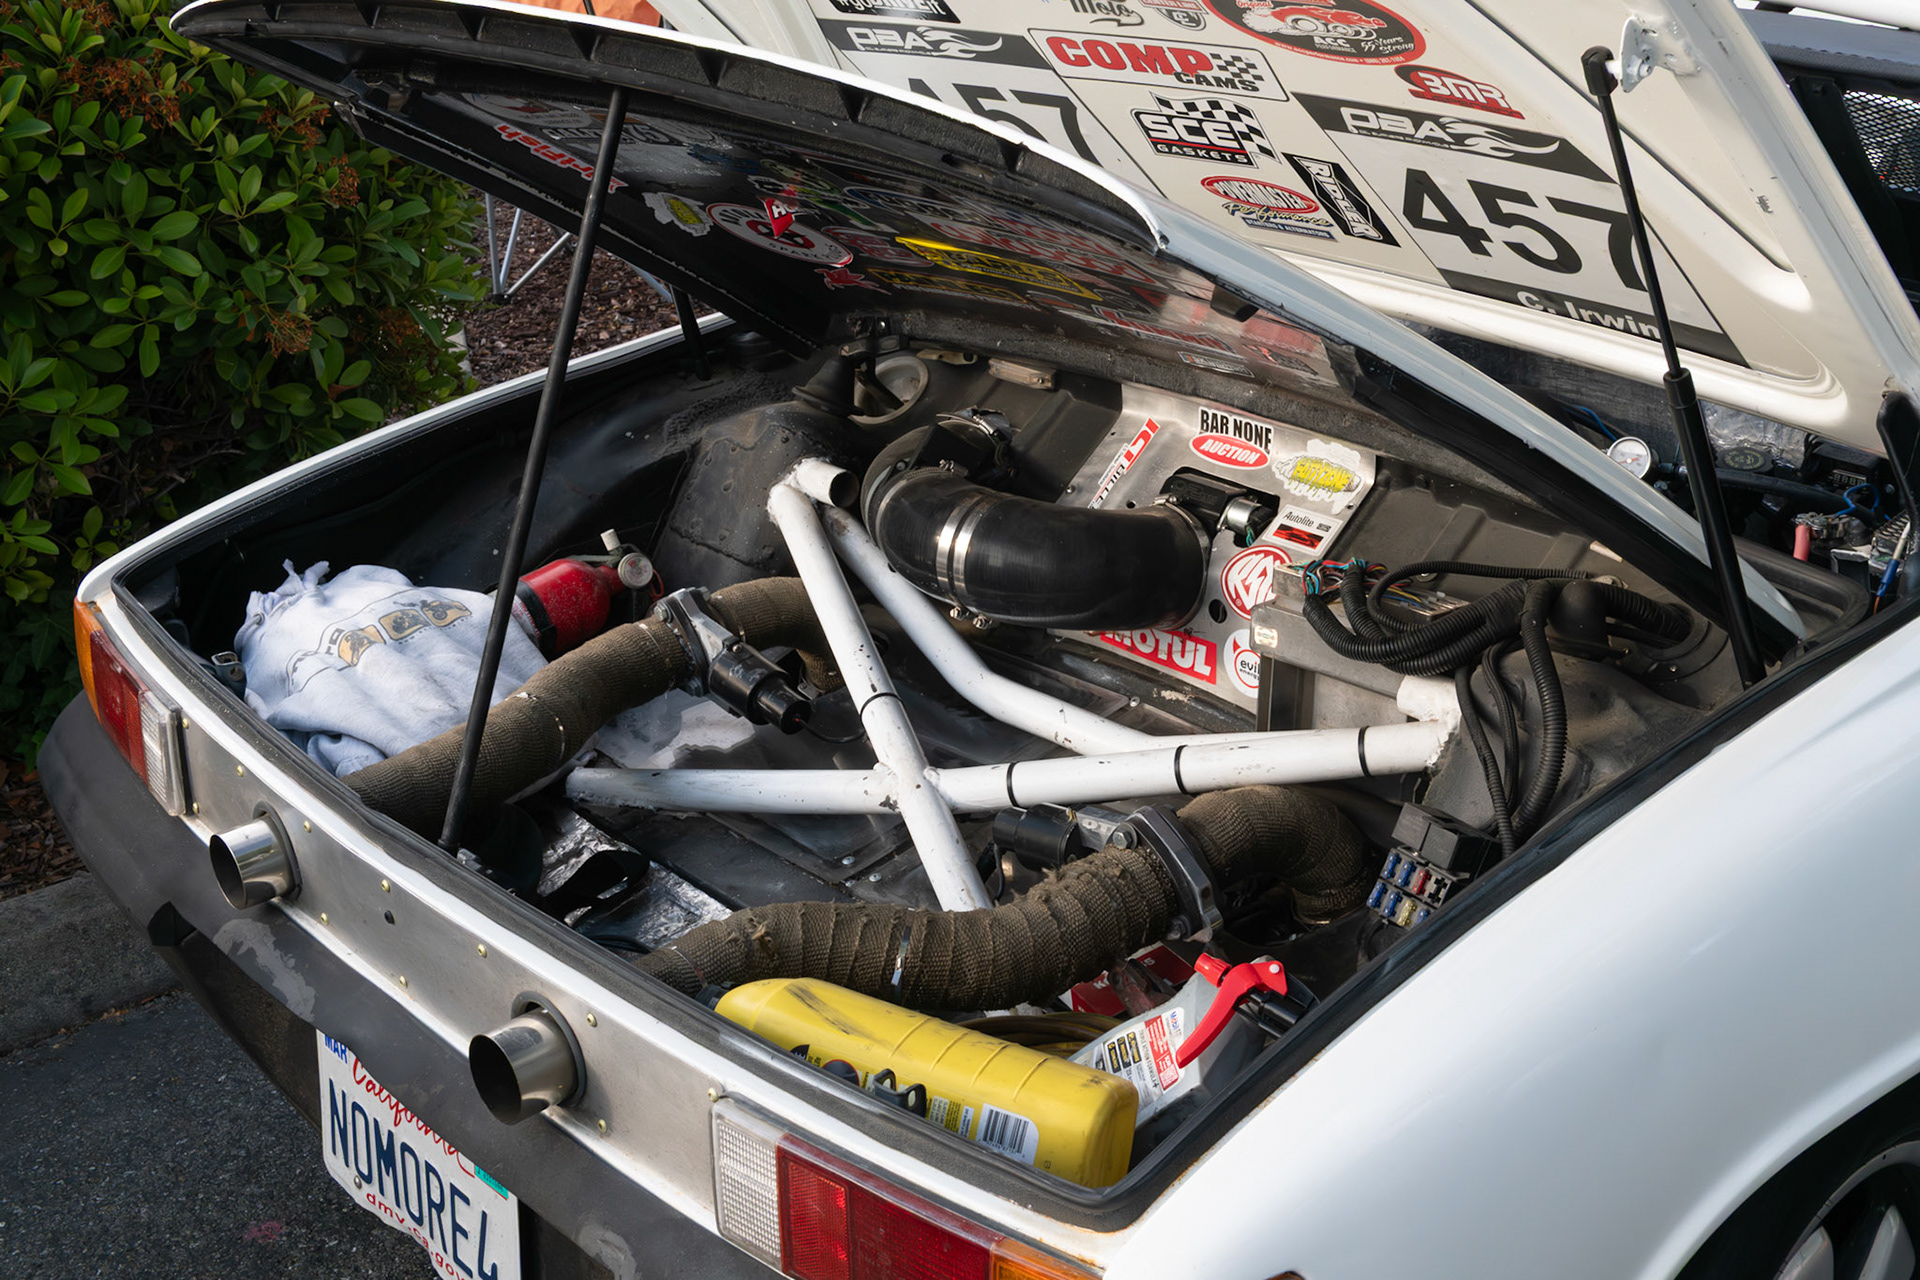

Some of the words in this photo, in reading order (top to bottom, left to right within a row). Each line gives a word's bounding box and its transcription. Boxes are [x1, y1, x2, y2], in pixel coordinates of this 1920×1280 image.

[1313, 36, 1350, 47] ACC
[1361, 41, 1376, 52] 55
[1375, 36, 1404, 46] Years
[1379, 42, 1415, 54] Strong
[1046, 36, 1214, 77] COMP
[1174, 72, 1260, 92] CAMS
[1417, 71, 1510, 109] BMR
[908, 78, 1104, 168] 57
[1139, 114, 1241, 149] SCE
[1157, 144, 1248, 163] GASKETS
[1213, 180, 1309, 209] POWERMASTER
[1308, 162, 1383, 240] RIDLER
[1222, 202, 1334, 227] Performance
[1247, 219, 1278, 230] STARTERS
[1284, 225, 1331, 238] ALTERNATORS
[1403, 168, 1649, 292] 457
[1566, 302, 1660, 339] Irwin
[1200, 409, 1229, 434] BAR
[1233, 418, 1273, 455] NONE
[1201, 438, 1261, 465] AUCTION
[1291, 457, 1354, 493] FATTYZONE
[1283, 511, 1315, 527] Autolite
[1240, 659, 1260, 675] evil
[367, 1192, 466, 1280] dmv.ca.gov
